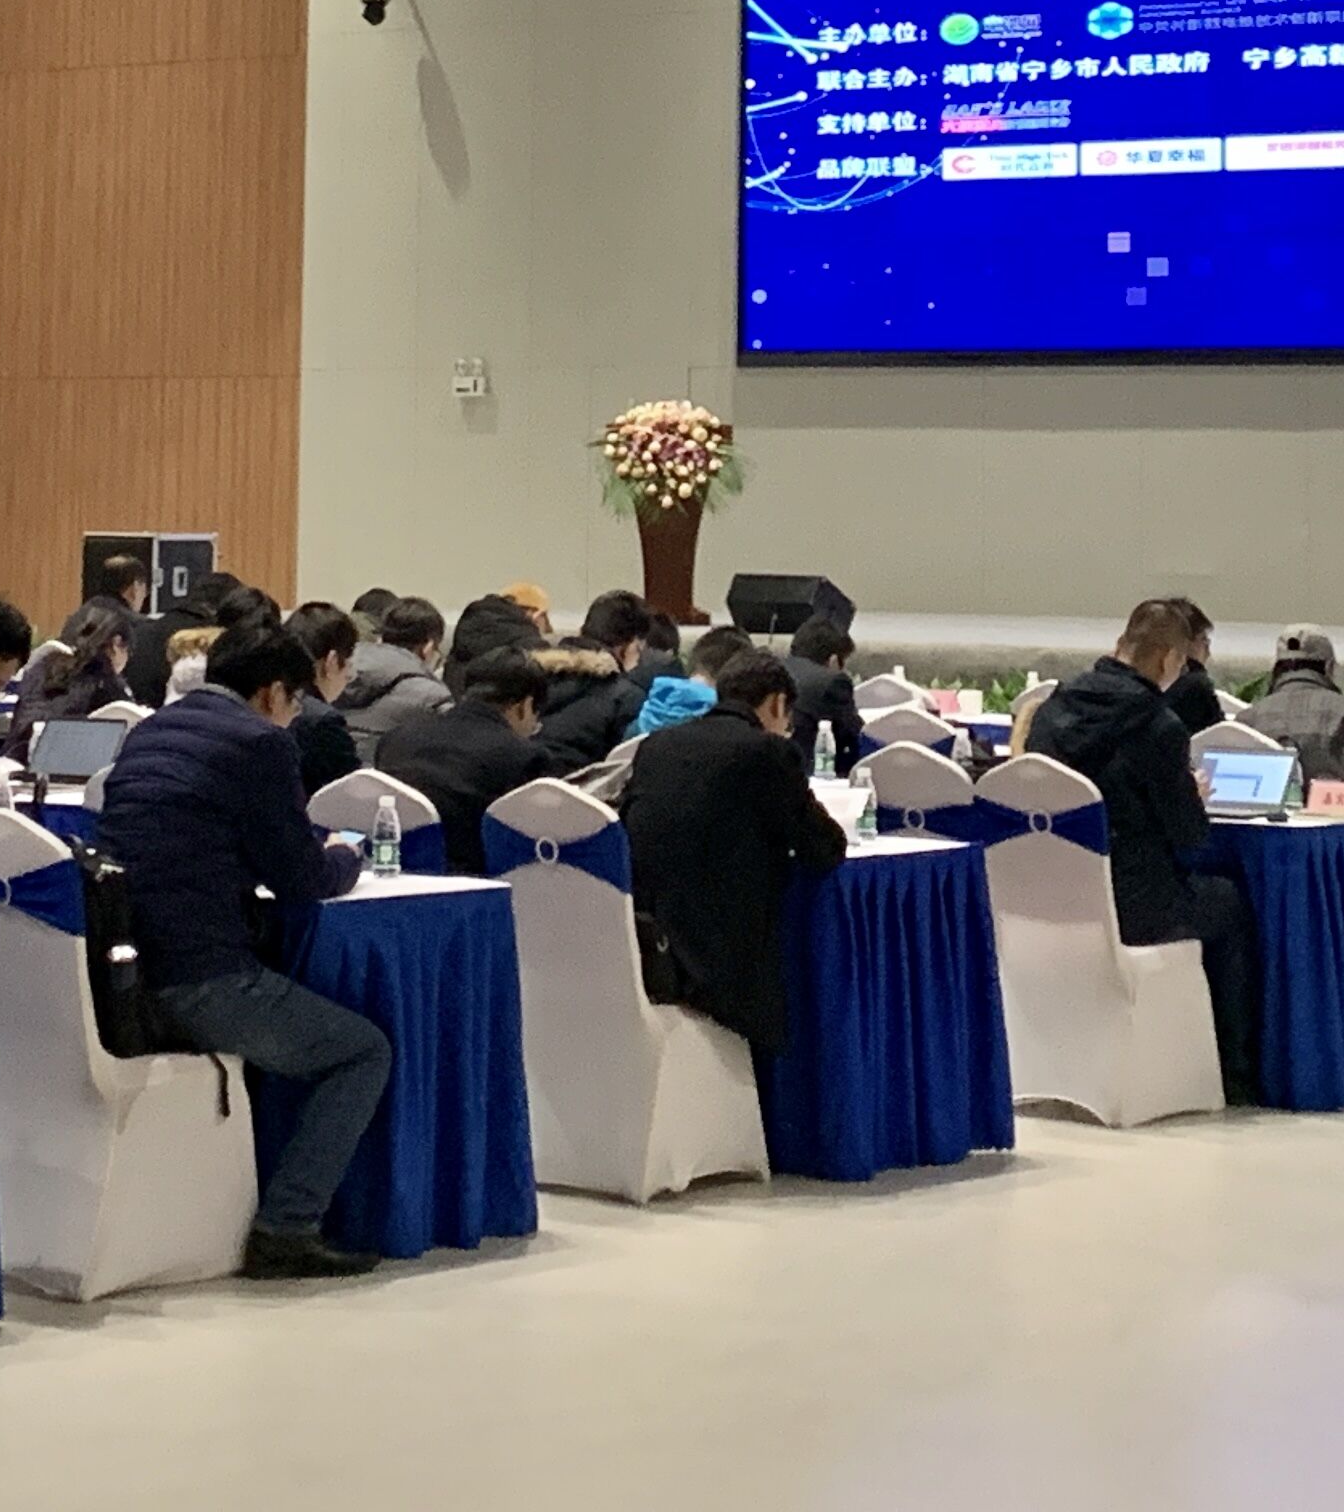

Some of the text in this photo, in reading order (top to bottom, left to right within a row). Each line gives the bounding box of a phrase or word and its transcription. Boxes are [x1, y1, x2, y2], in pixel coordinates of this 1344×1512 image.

[942, 51, 1210, 87] 湖南省宁乡市人民政府
